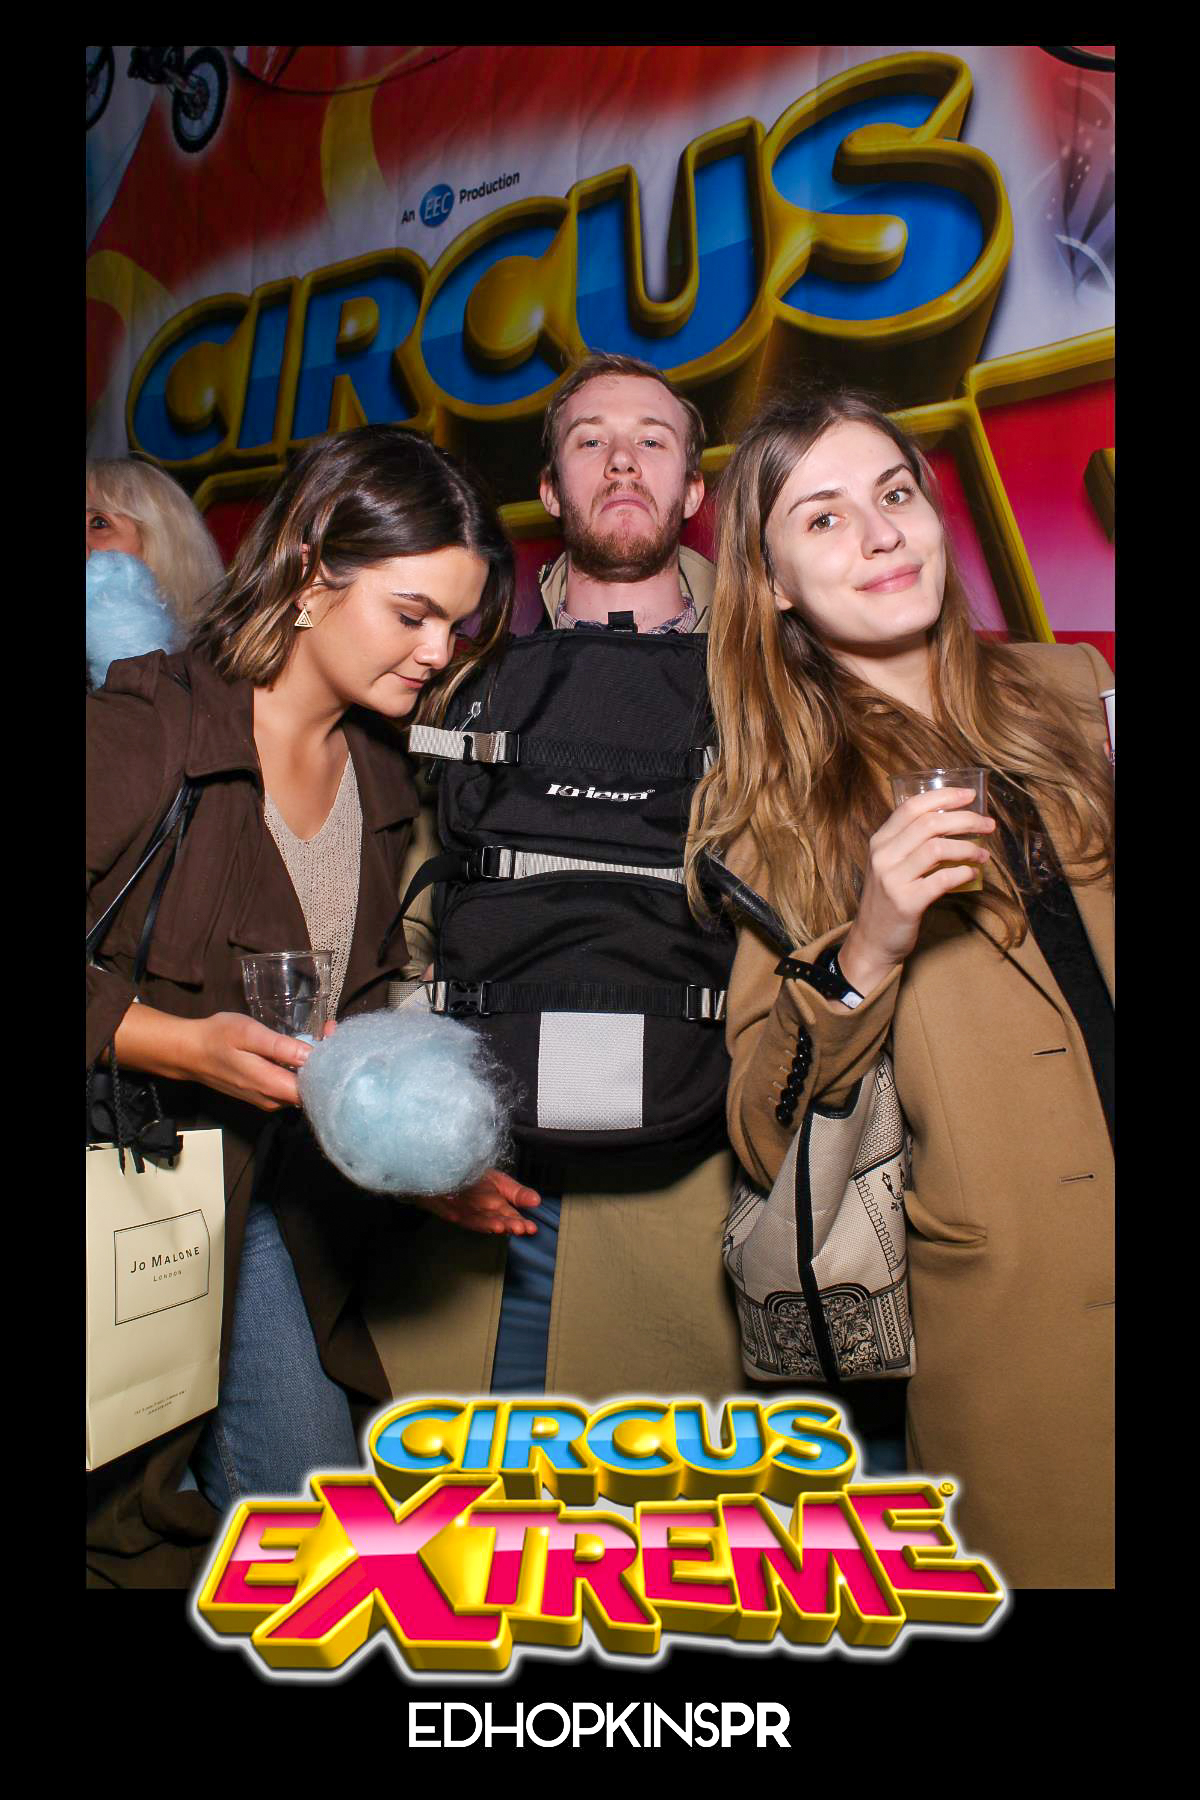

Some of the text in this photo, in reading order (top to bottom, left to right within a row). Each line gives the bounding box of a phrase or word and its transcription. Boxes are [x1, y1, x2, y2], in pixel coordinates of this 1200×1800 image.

[125, 51, 1014, 467] CIRCUS
[401, 172, 520, 225] An EEC Production
